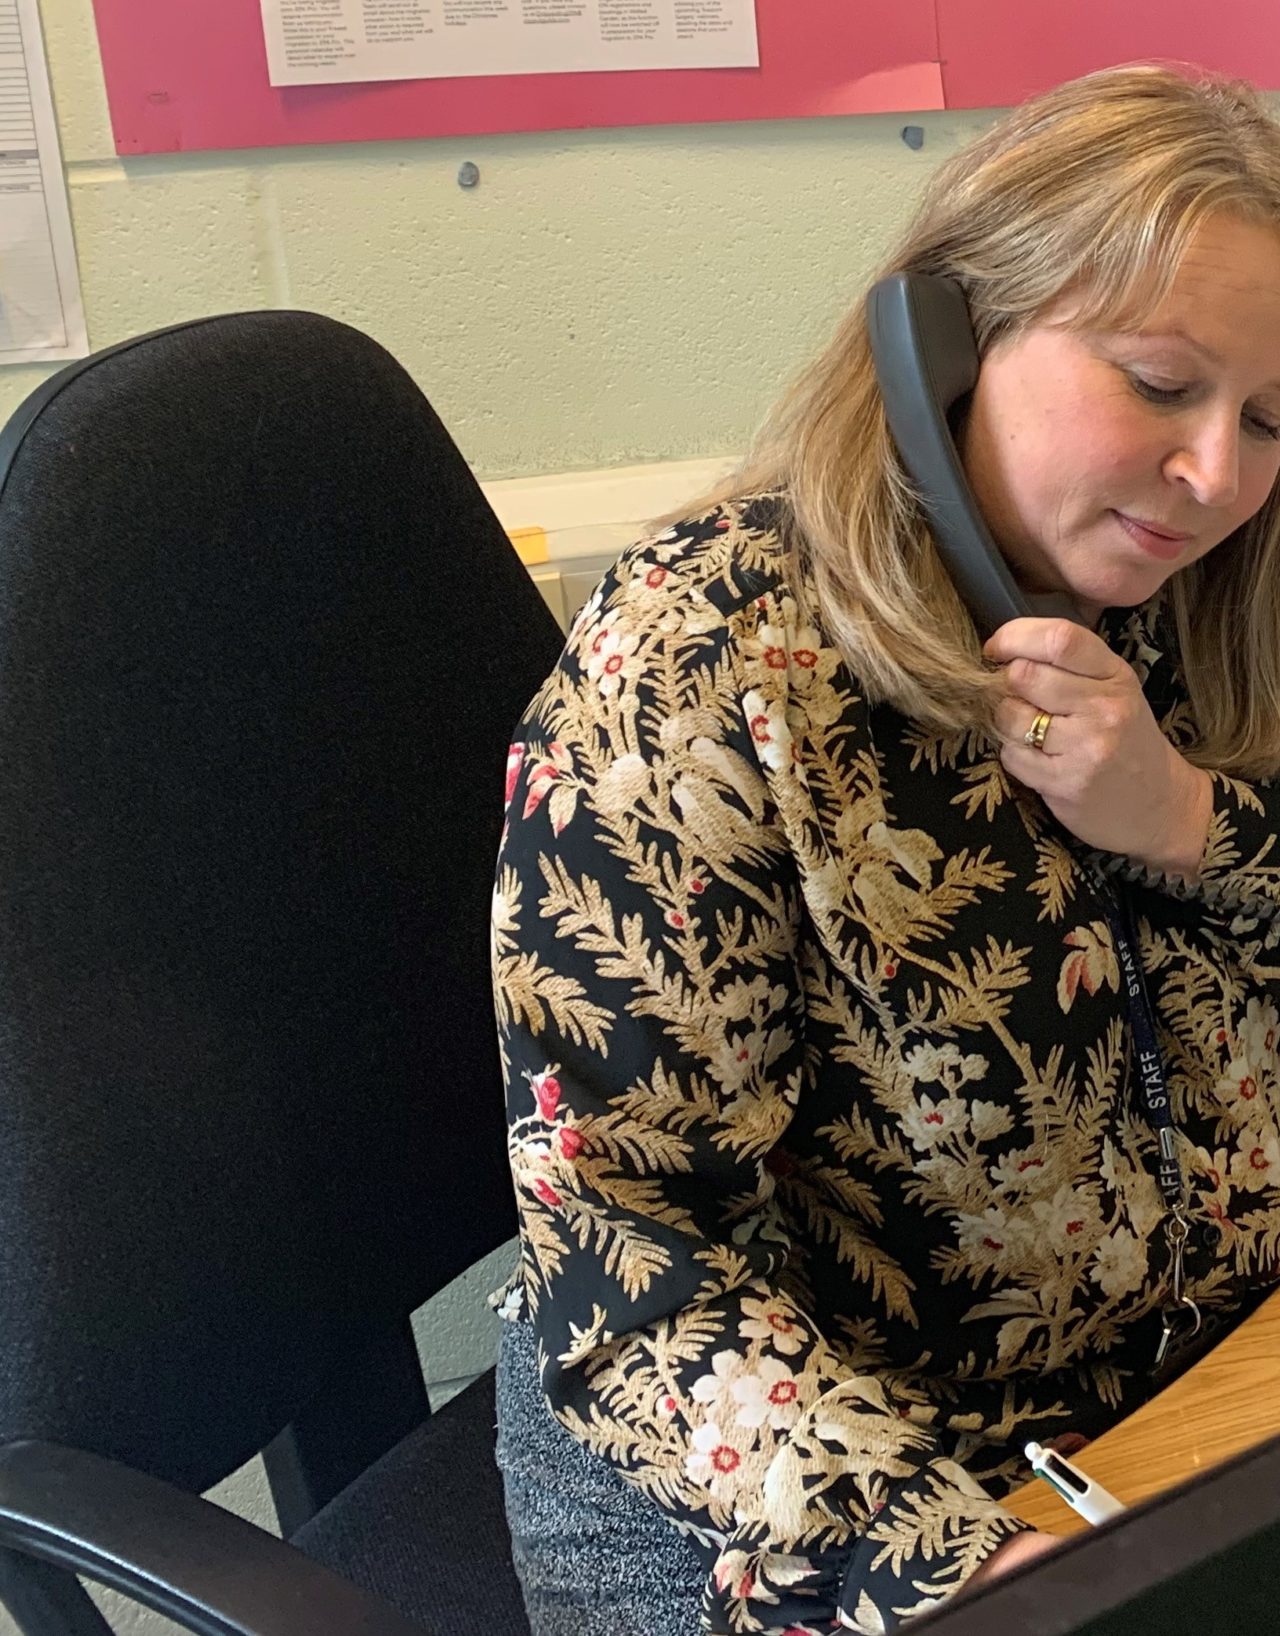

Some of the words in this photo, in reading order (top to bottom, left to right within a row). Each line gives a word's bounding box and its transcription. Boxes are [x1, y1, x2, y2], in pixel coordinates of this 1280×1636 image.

[1118, 940, 1140, 997] STAFF
[1140, 1051, 1167, 1109] STAFF
[1160, 1164, 1178, 1197] AFF
